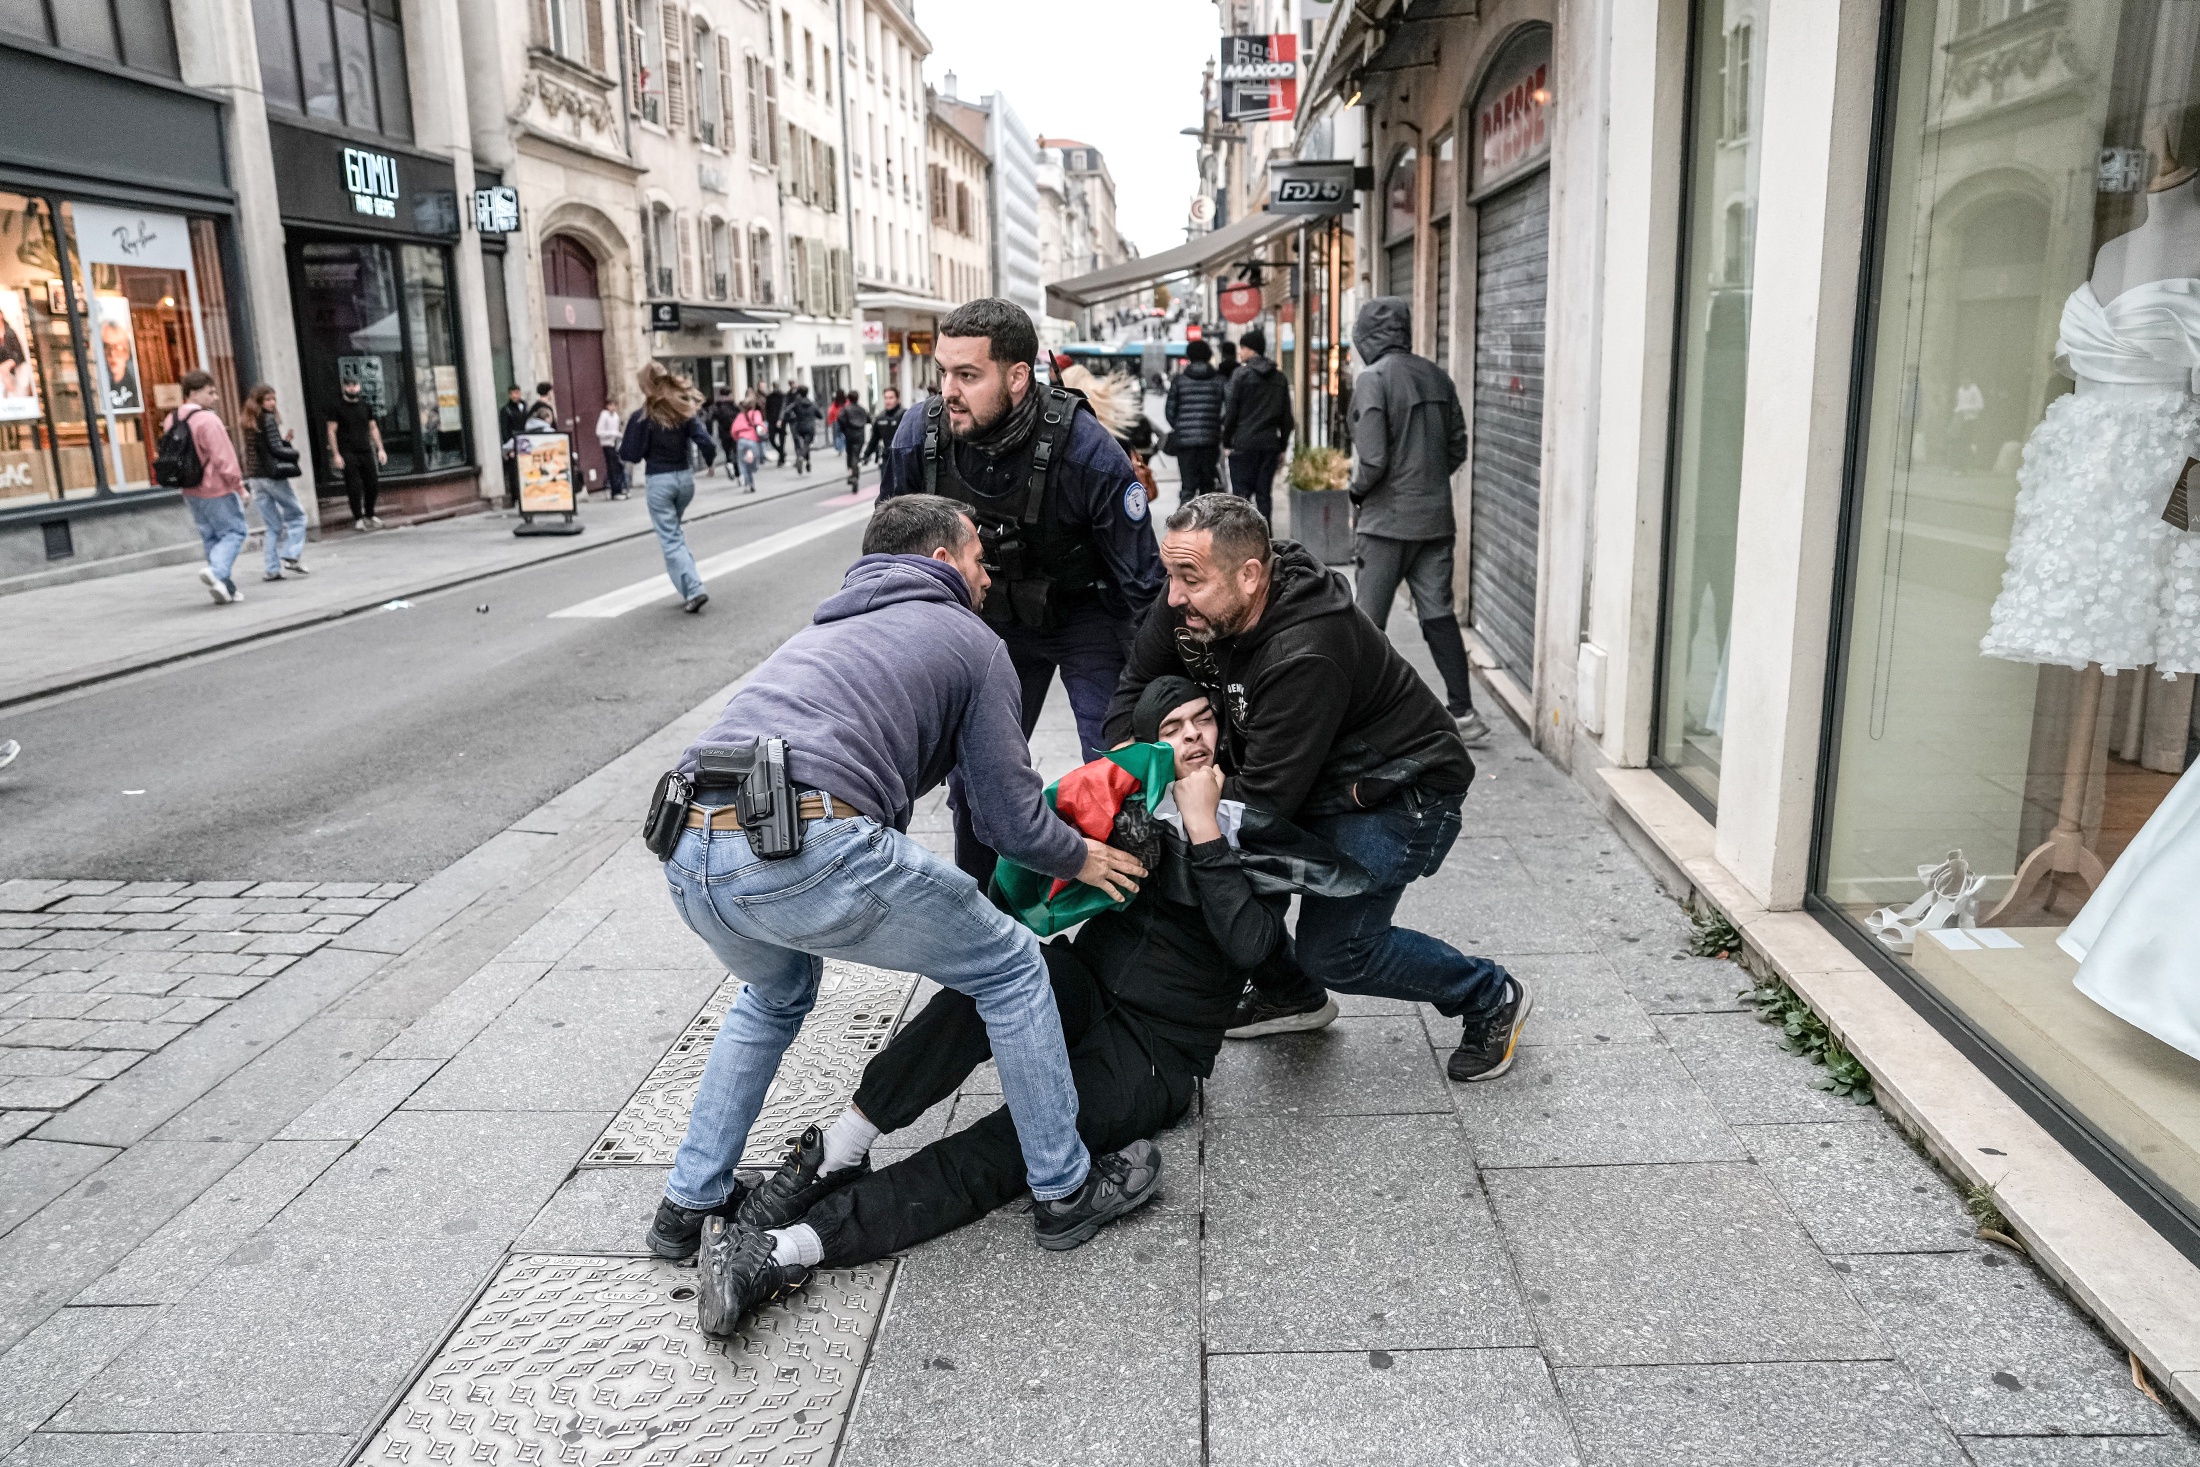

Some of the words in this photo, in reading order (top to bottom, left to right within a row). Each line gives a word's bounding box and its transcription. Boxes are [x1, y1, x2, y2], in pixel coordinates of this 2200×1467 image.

[344, 147, 399, 199] GOMU
[1282, 181, 1320, 199] FDJ
[0, 462, 33, 489] AC
